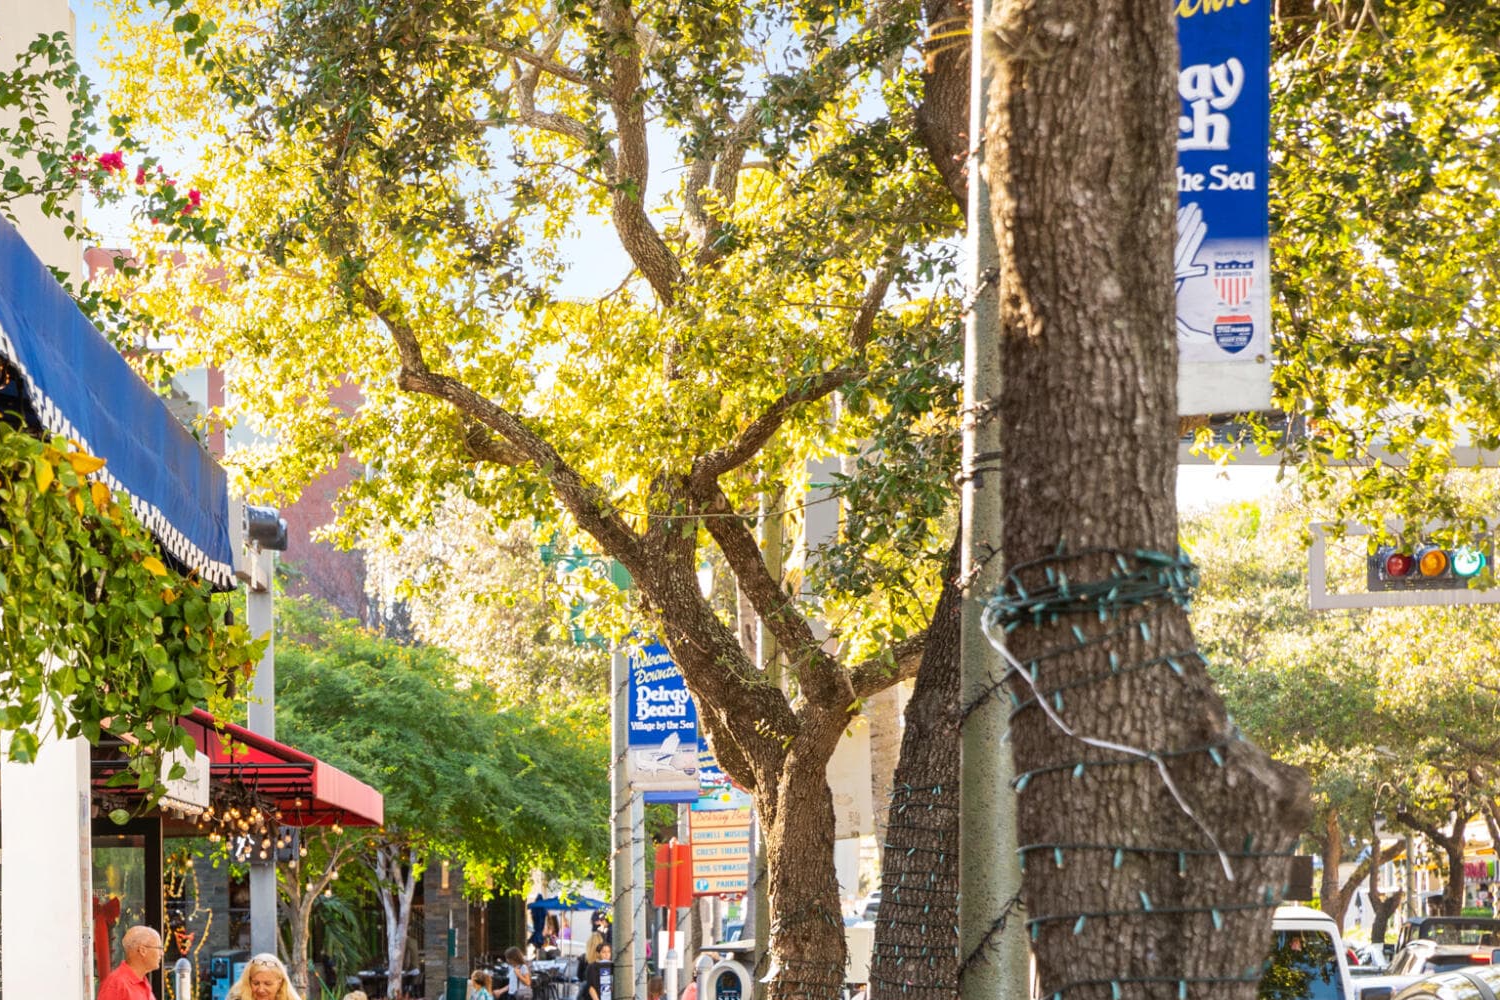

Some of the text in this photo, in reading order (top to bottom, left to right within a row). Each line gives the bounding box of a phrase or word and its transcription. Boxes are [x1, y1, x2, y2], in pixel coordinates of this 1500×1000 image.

[1176, 164, 1256, 192] he Sea
[636, 685, 690, 704] Delray
[636, 700, 686, 721] Beach
[630, 719, 694, 732] Village by the Sea
